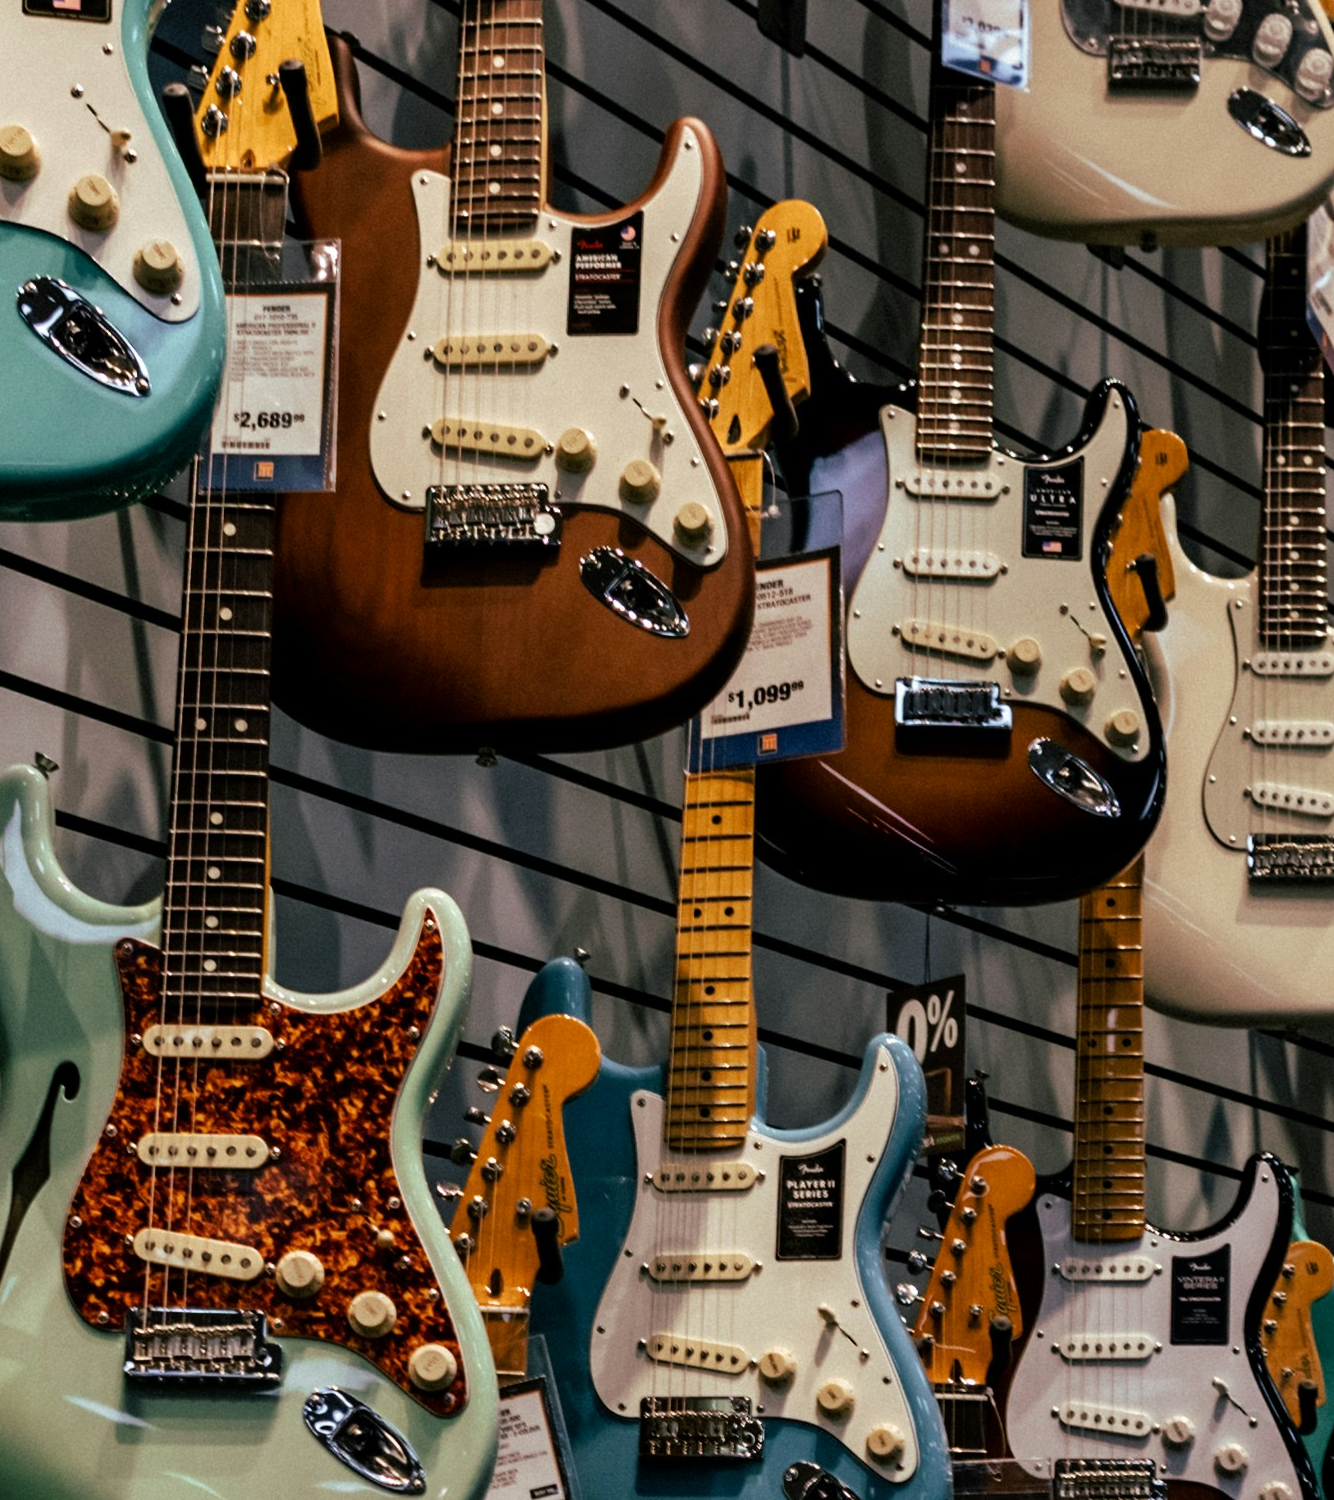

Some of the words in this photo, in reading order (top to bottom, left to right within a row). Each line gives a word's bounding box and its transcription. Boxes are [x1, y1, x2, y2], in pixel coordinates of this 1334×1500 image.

[575, 253, 619, 262] AMERICAN
[575, 262, 622, 270] PERFORMER
[757, 579, 784, 590] NDER
[897, 989, 959, 1066] 0%
[786, 1180, 827, 1189] PLAYER
[792, 1189, 829, 1199] SERIES
